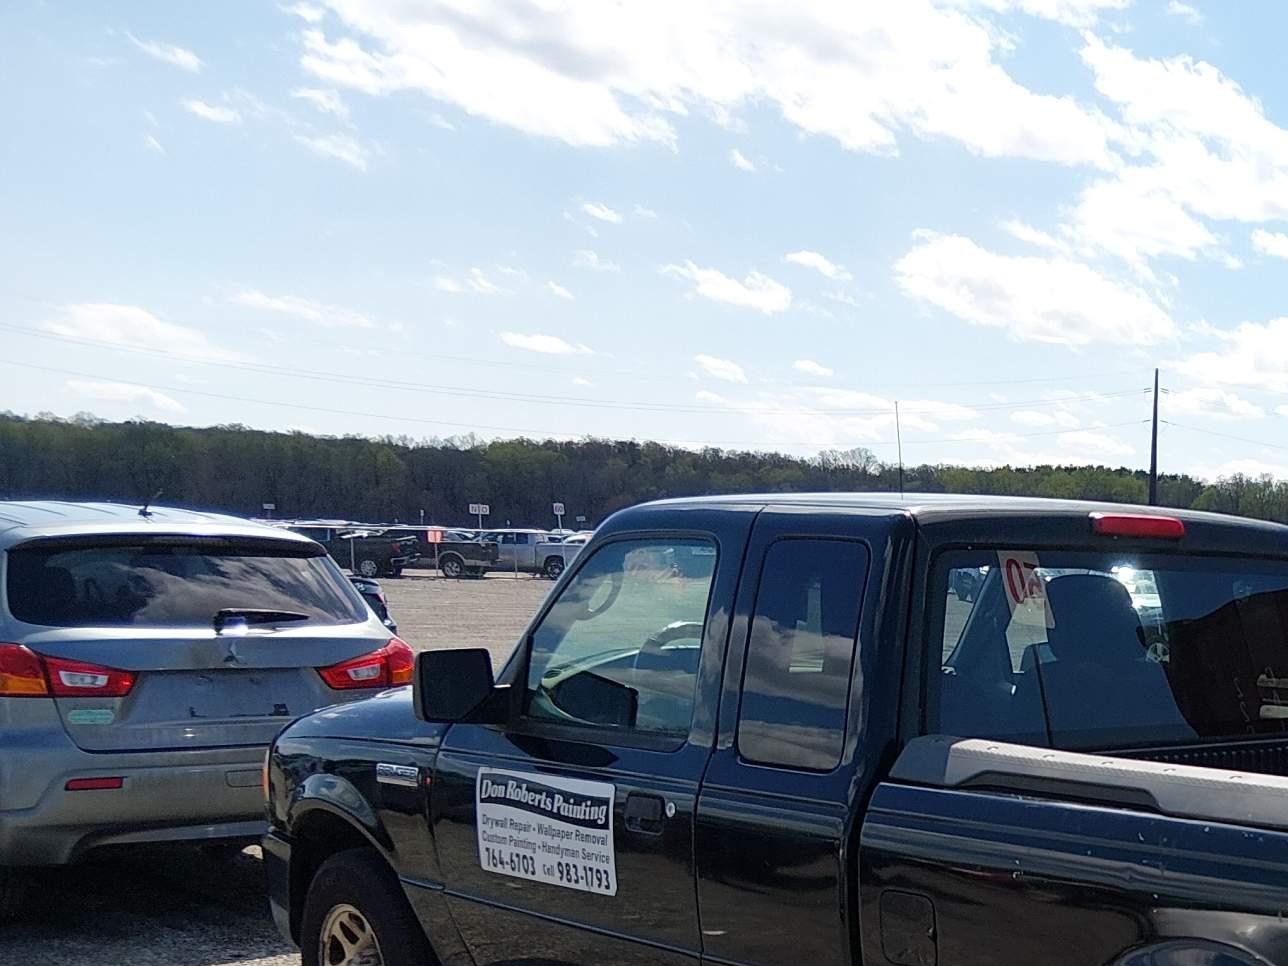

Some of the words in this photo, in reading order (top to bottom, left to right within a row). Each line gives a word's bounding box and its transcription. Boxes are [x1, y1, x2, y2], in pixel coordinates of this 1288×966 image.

[481, 779, 506, 799] Don
[506, 780, 553, 811] Roberts
[552, 794, 608, 825] Painting
[537, 823, 574, 841] Wallpaper
[575, 829, 608, 846] Removal
[485, 847, 536, 876] 764-6703
[557, 861, 611, 890] 983-1793
[542, 841, 579, 858] Handyman
[581, 848, 610, 864] Service
